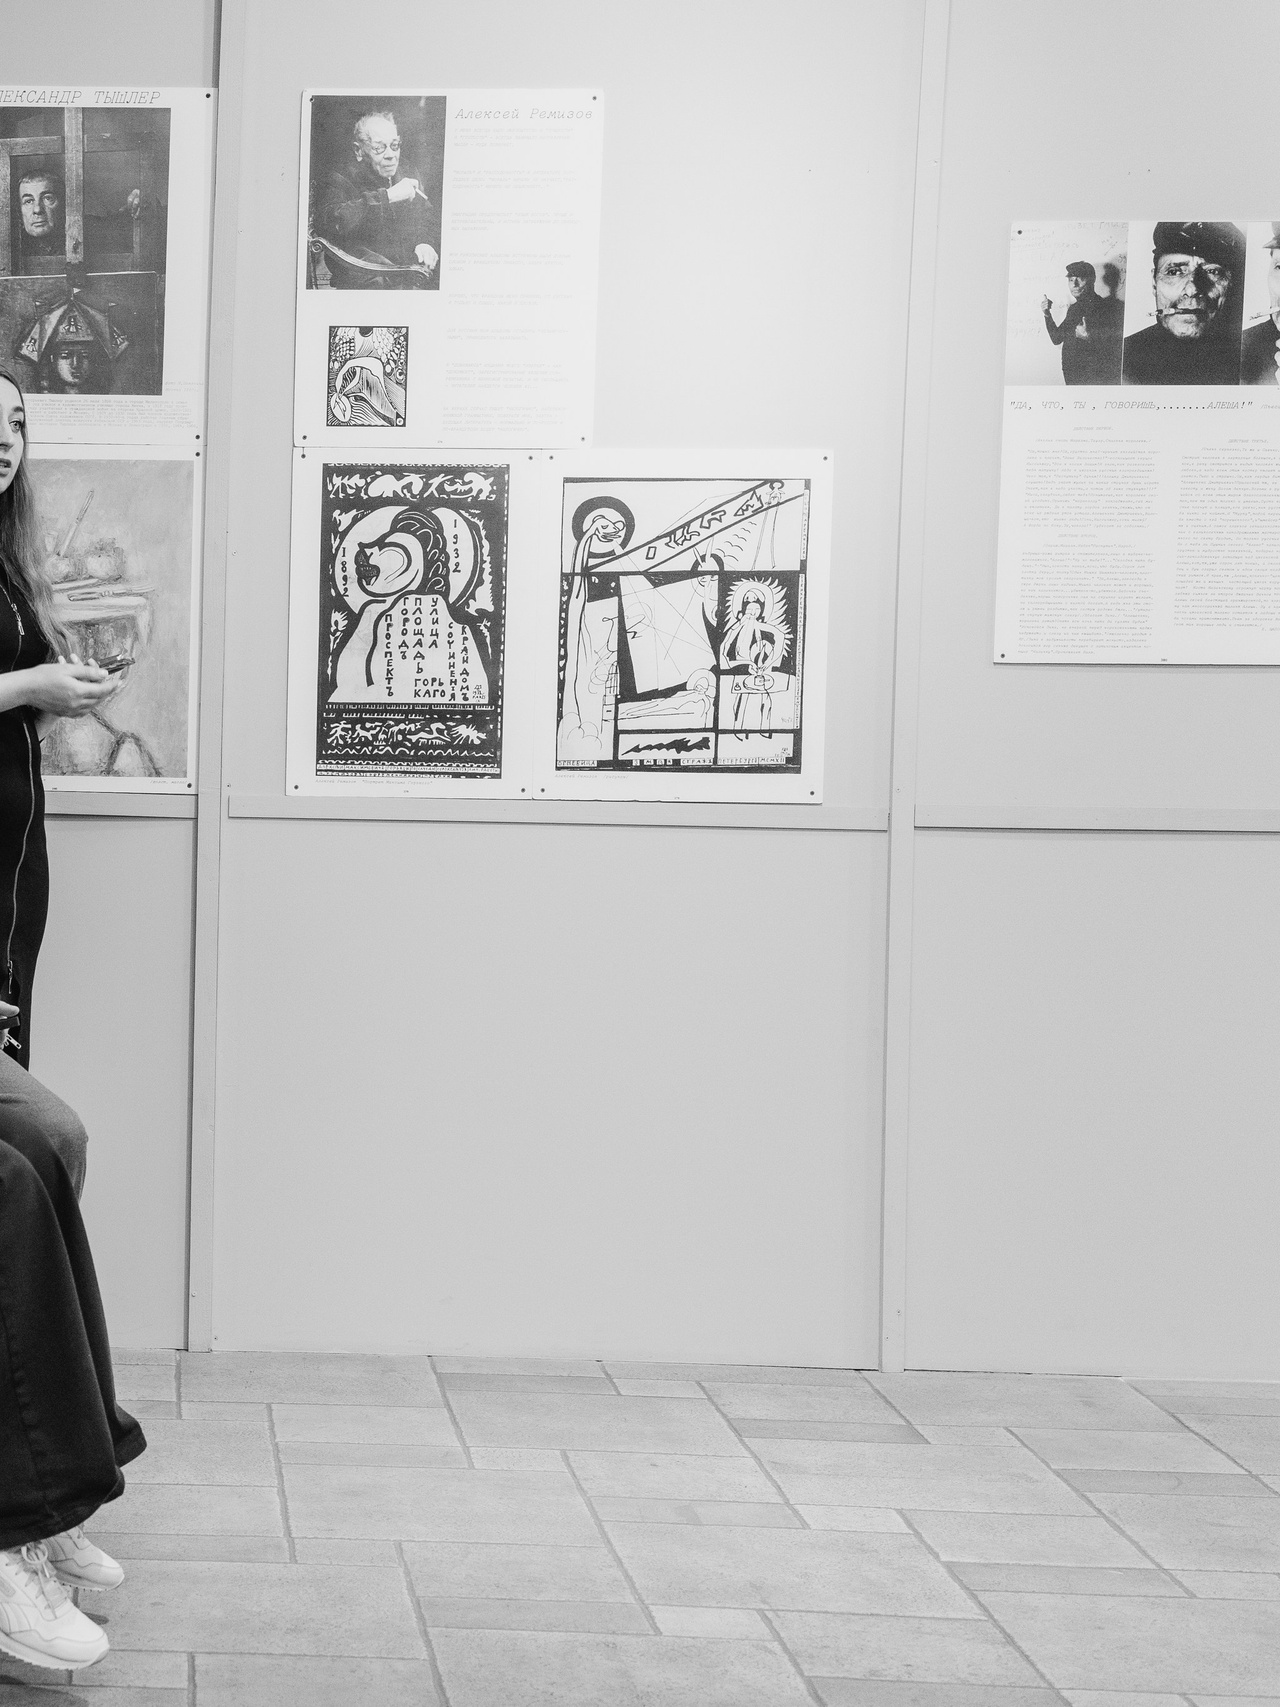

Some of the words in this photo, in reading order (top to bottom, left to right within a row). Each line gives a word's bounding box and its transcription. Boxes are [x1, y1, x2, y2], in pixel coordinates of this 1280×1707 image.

[94, 90, 161, 105] ТЫШЛЕР
[455, 107, 520, 119] Алексей
[529, 107, 593, 119] Ремизов
[1009, 400, 1033, 411] "ДА,
[1041, 400, 1064, 411] ЧТО,
[1072, 400, 1087, 409] ТЫ
[340, 547, 349, 597] 1892
[452, 519, 461, 574] 1932
[398, 597, 410, 660] ГОРОДЪ
[412, 597, 425, 674] ПЛОЩАДЬ
[428, 597, 439, 649] УЛИЦА
[384, 613, 394, 697] ПРОСПЕКТЪ
[460, 667, 470, 702] ДОМЪ
